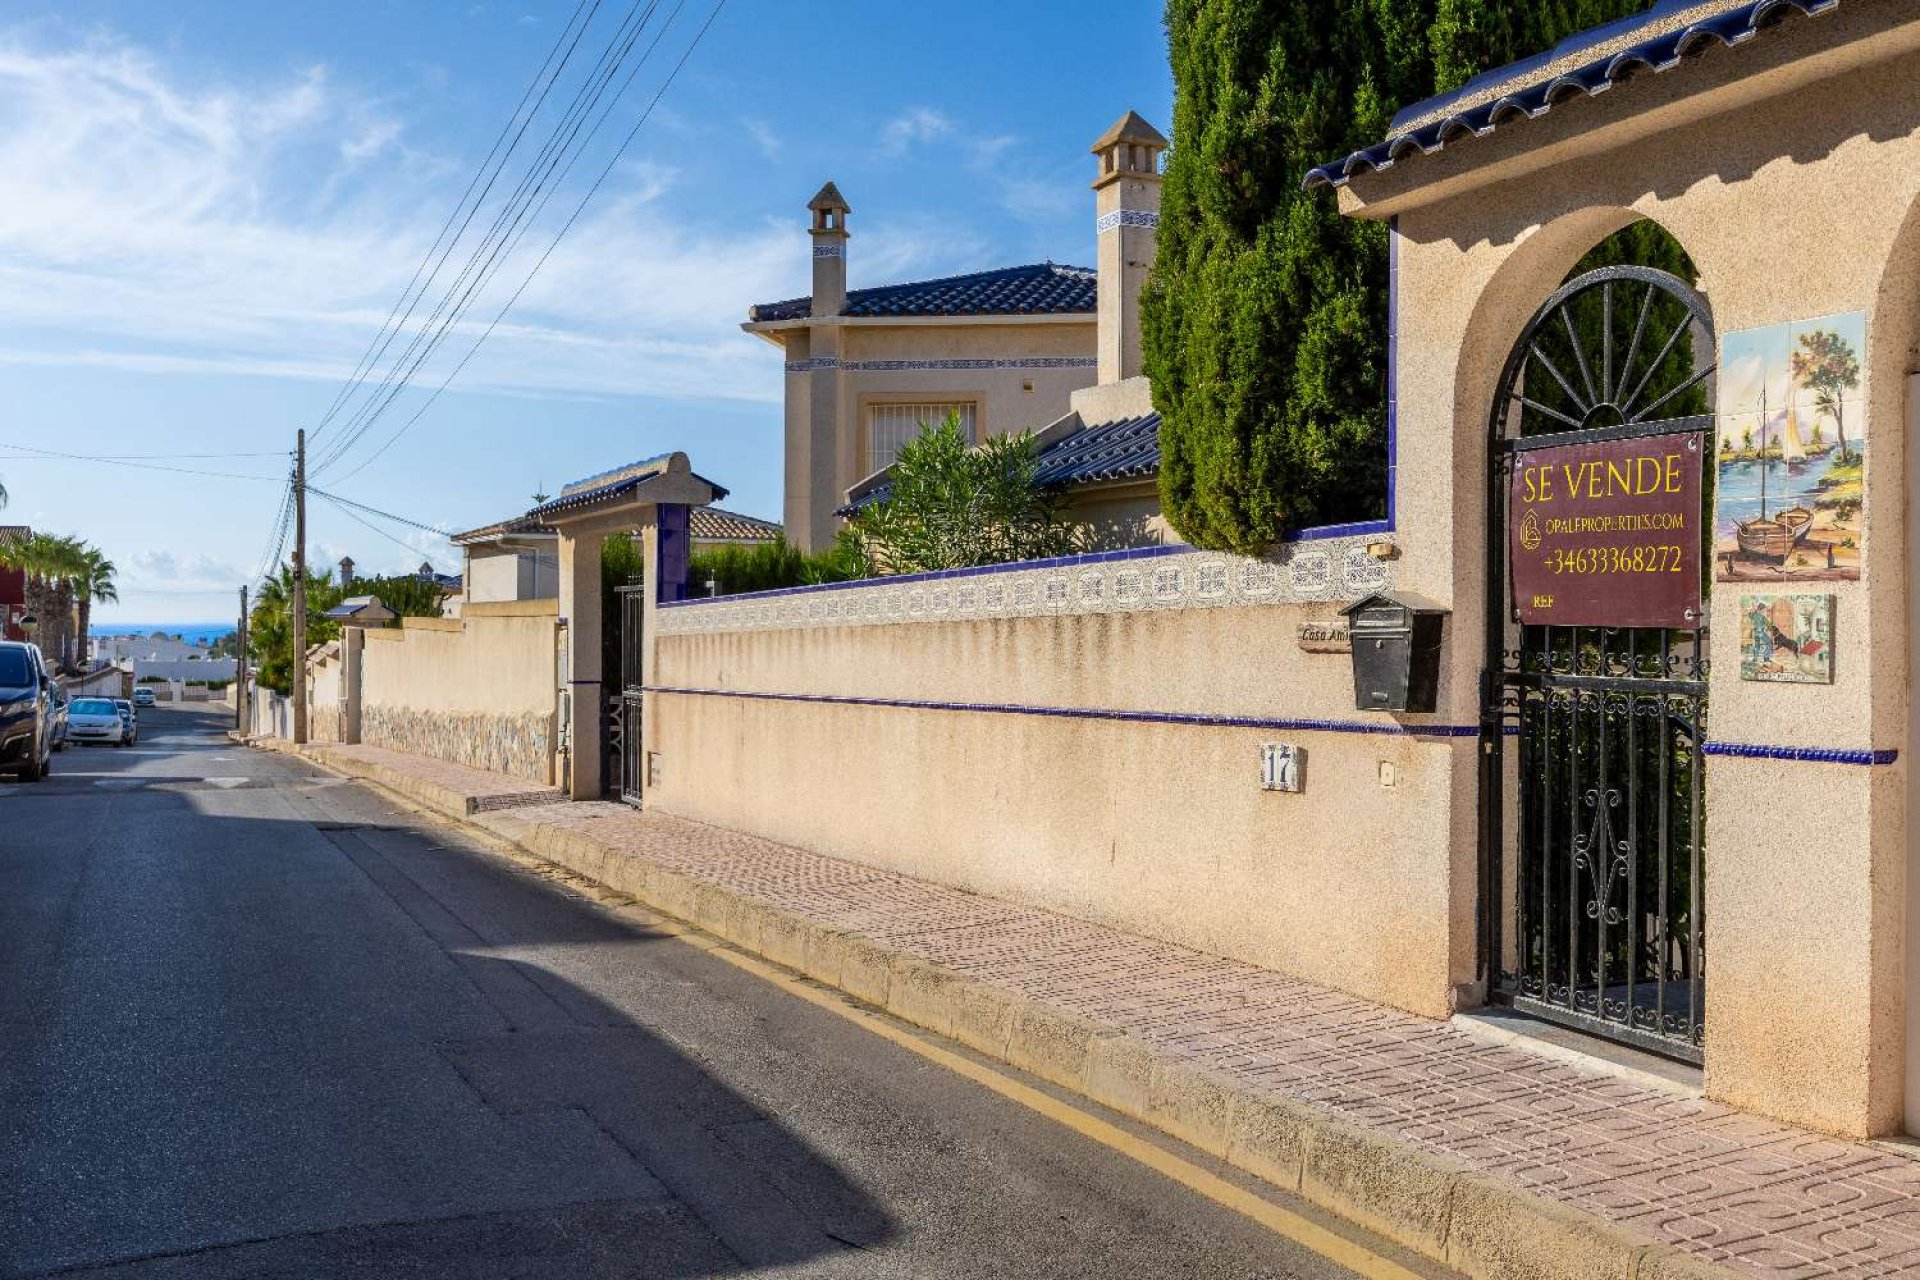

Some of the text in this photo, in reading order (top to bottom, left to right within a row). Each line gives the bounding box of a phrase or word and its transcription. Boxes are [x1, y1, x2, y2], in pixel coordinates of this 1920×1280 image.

[1522, 454, 1682, 502] SE VENDE
[1544, 545, 1682, 574] +34633368272
[1302, 628, 1327, 641] Casa
[1268, 752, 1291, 782] 17
